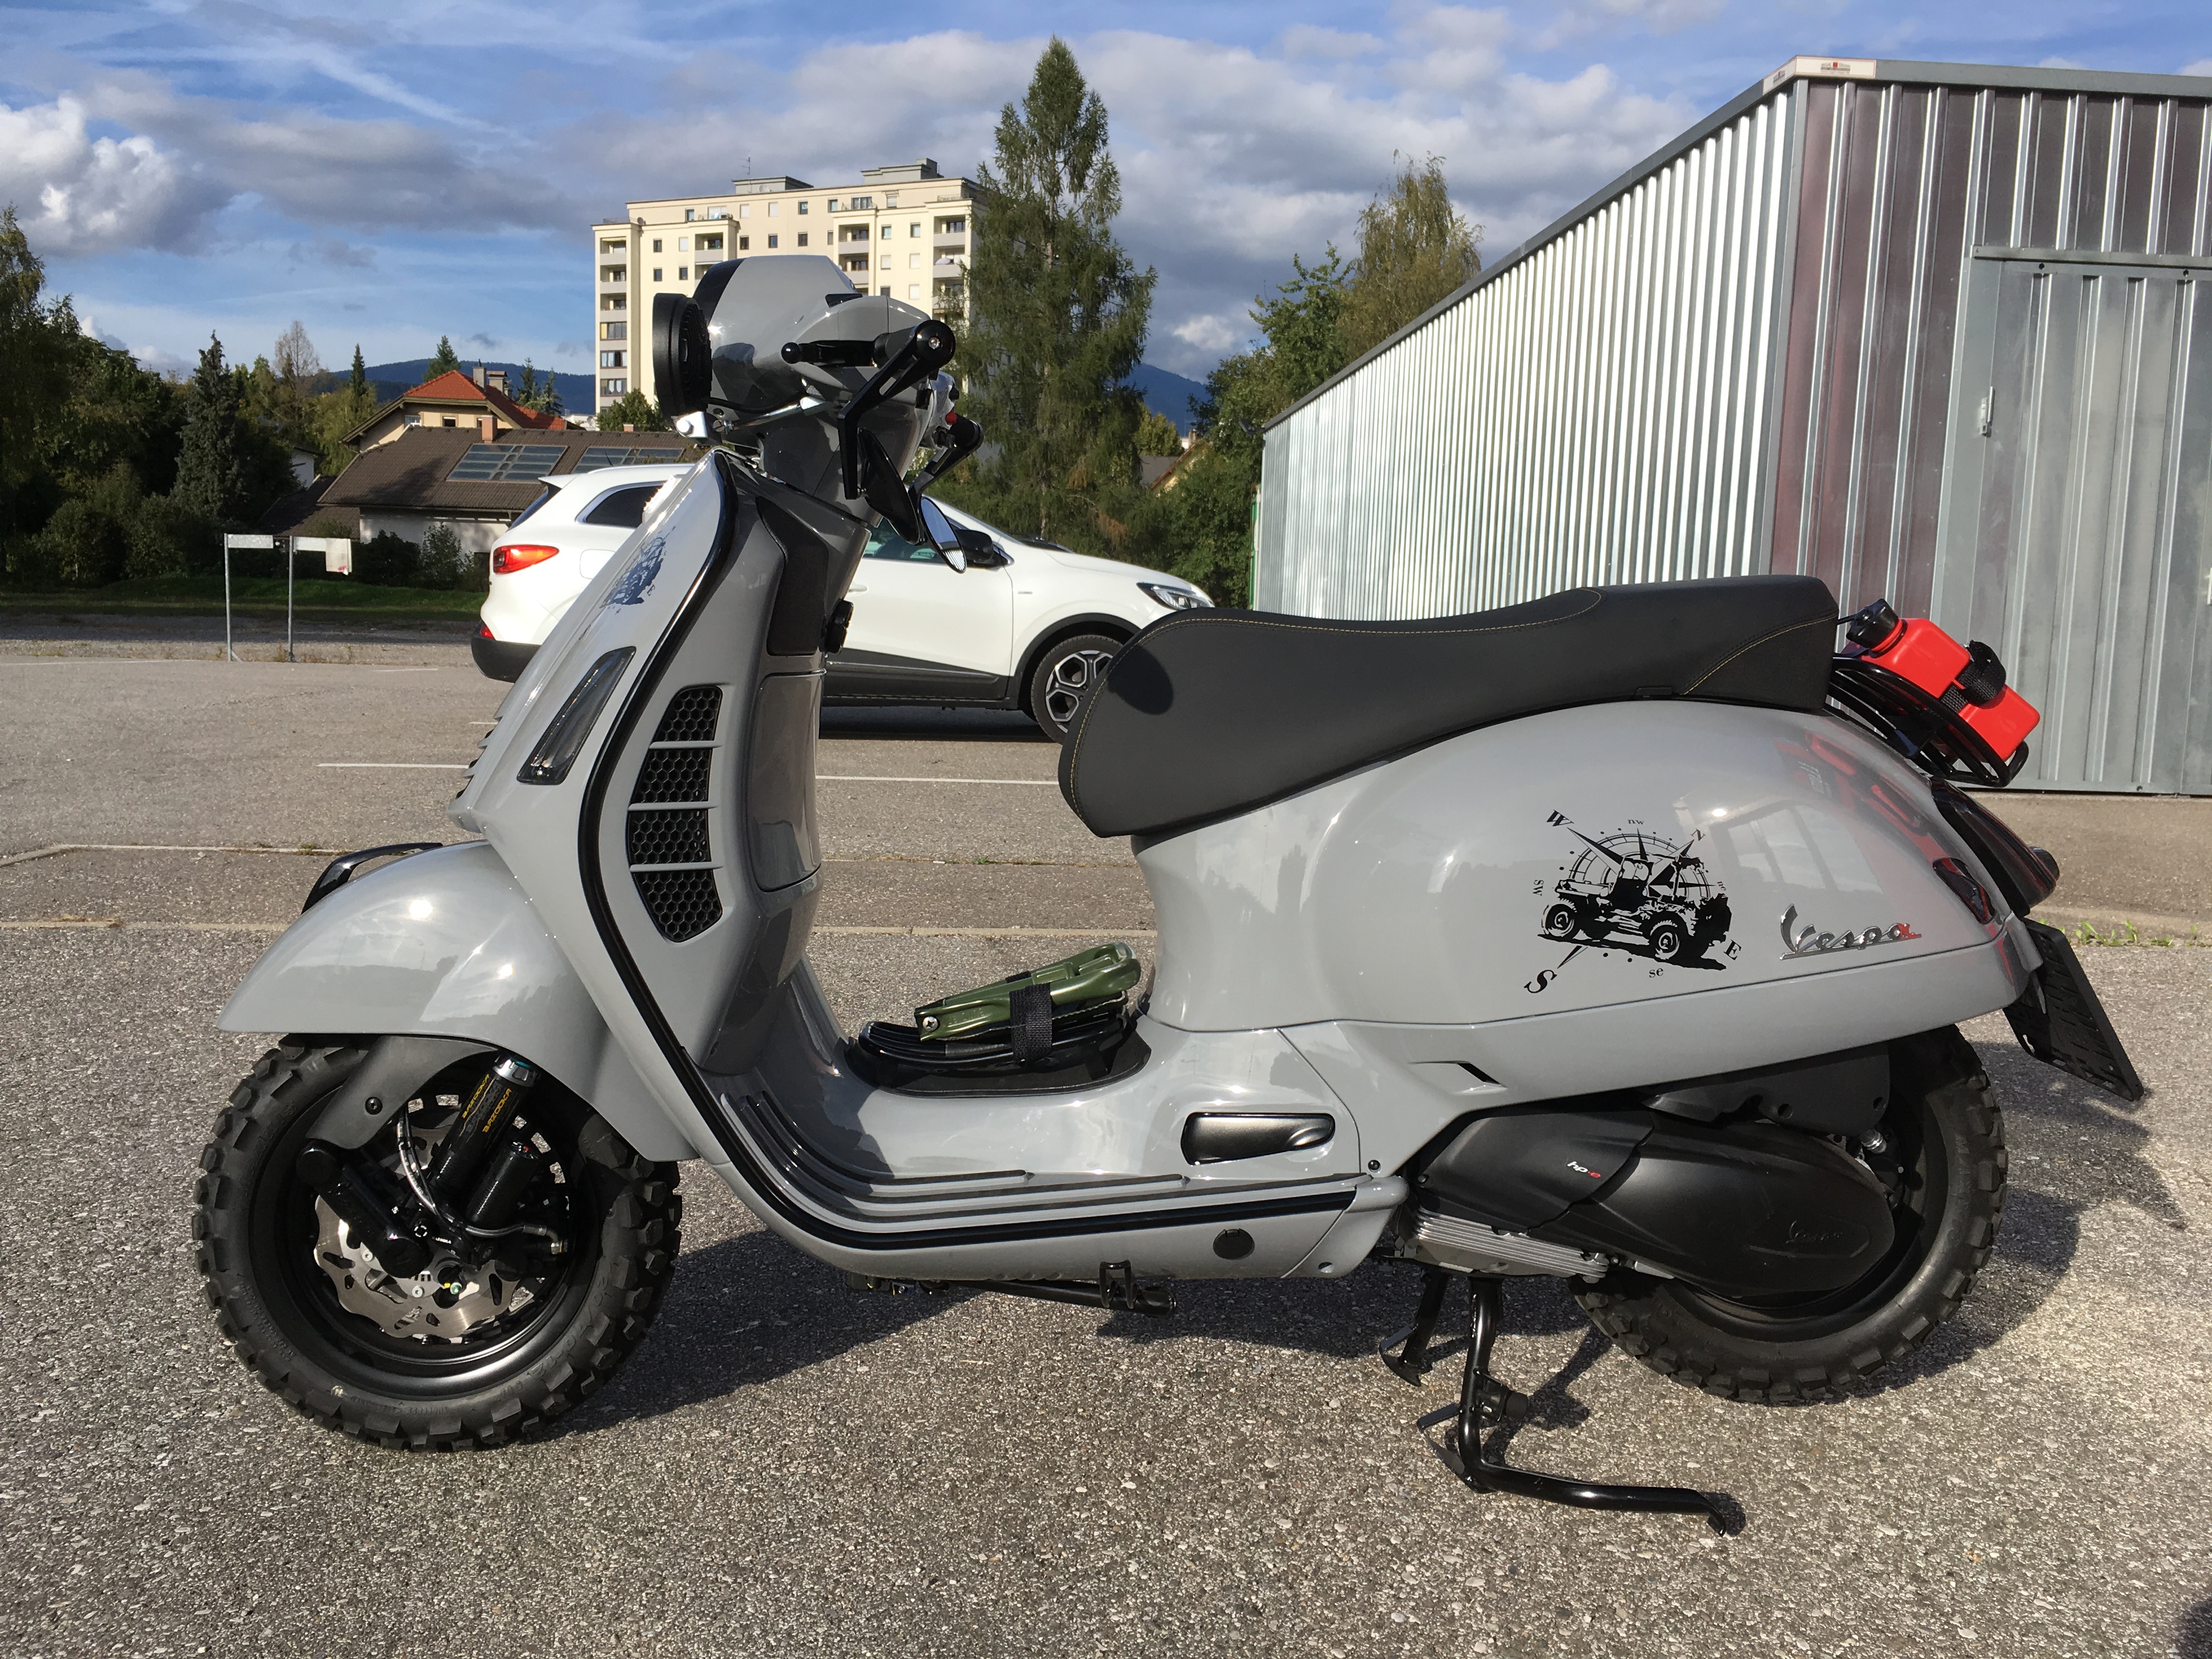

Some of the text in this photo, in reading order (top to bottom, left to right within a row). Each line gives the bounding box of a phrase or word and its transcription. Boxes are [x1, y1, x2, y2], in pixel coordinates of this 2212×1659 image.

[1546, 809, 1575, 827] W
[1690, 828, 1706, 841] N
[1780, 903, 1922, 961] Vespa
[1723, 939, 1742, 961] E
[1523, 969, 1558, 994] S
[1649, 967, 1664, 979] se
[462, 1074, 489, 1119] BAZOOKA
[482, 1088, 512, 1133] BAZOOKA
